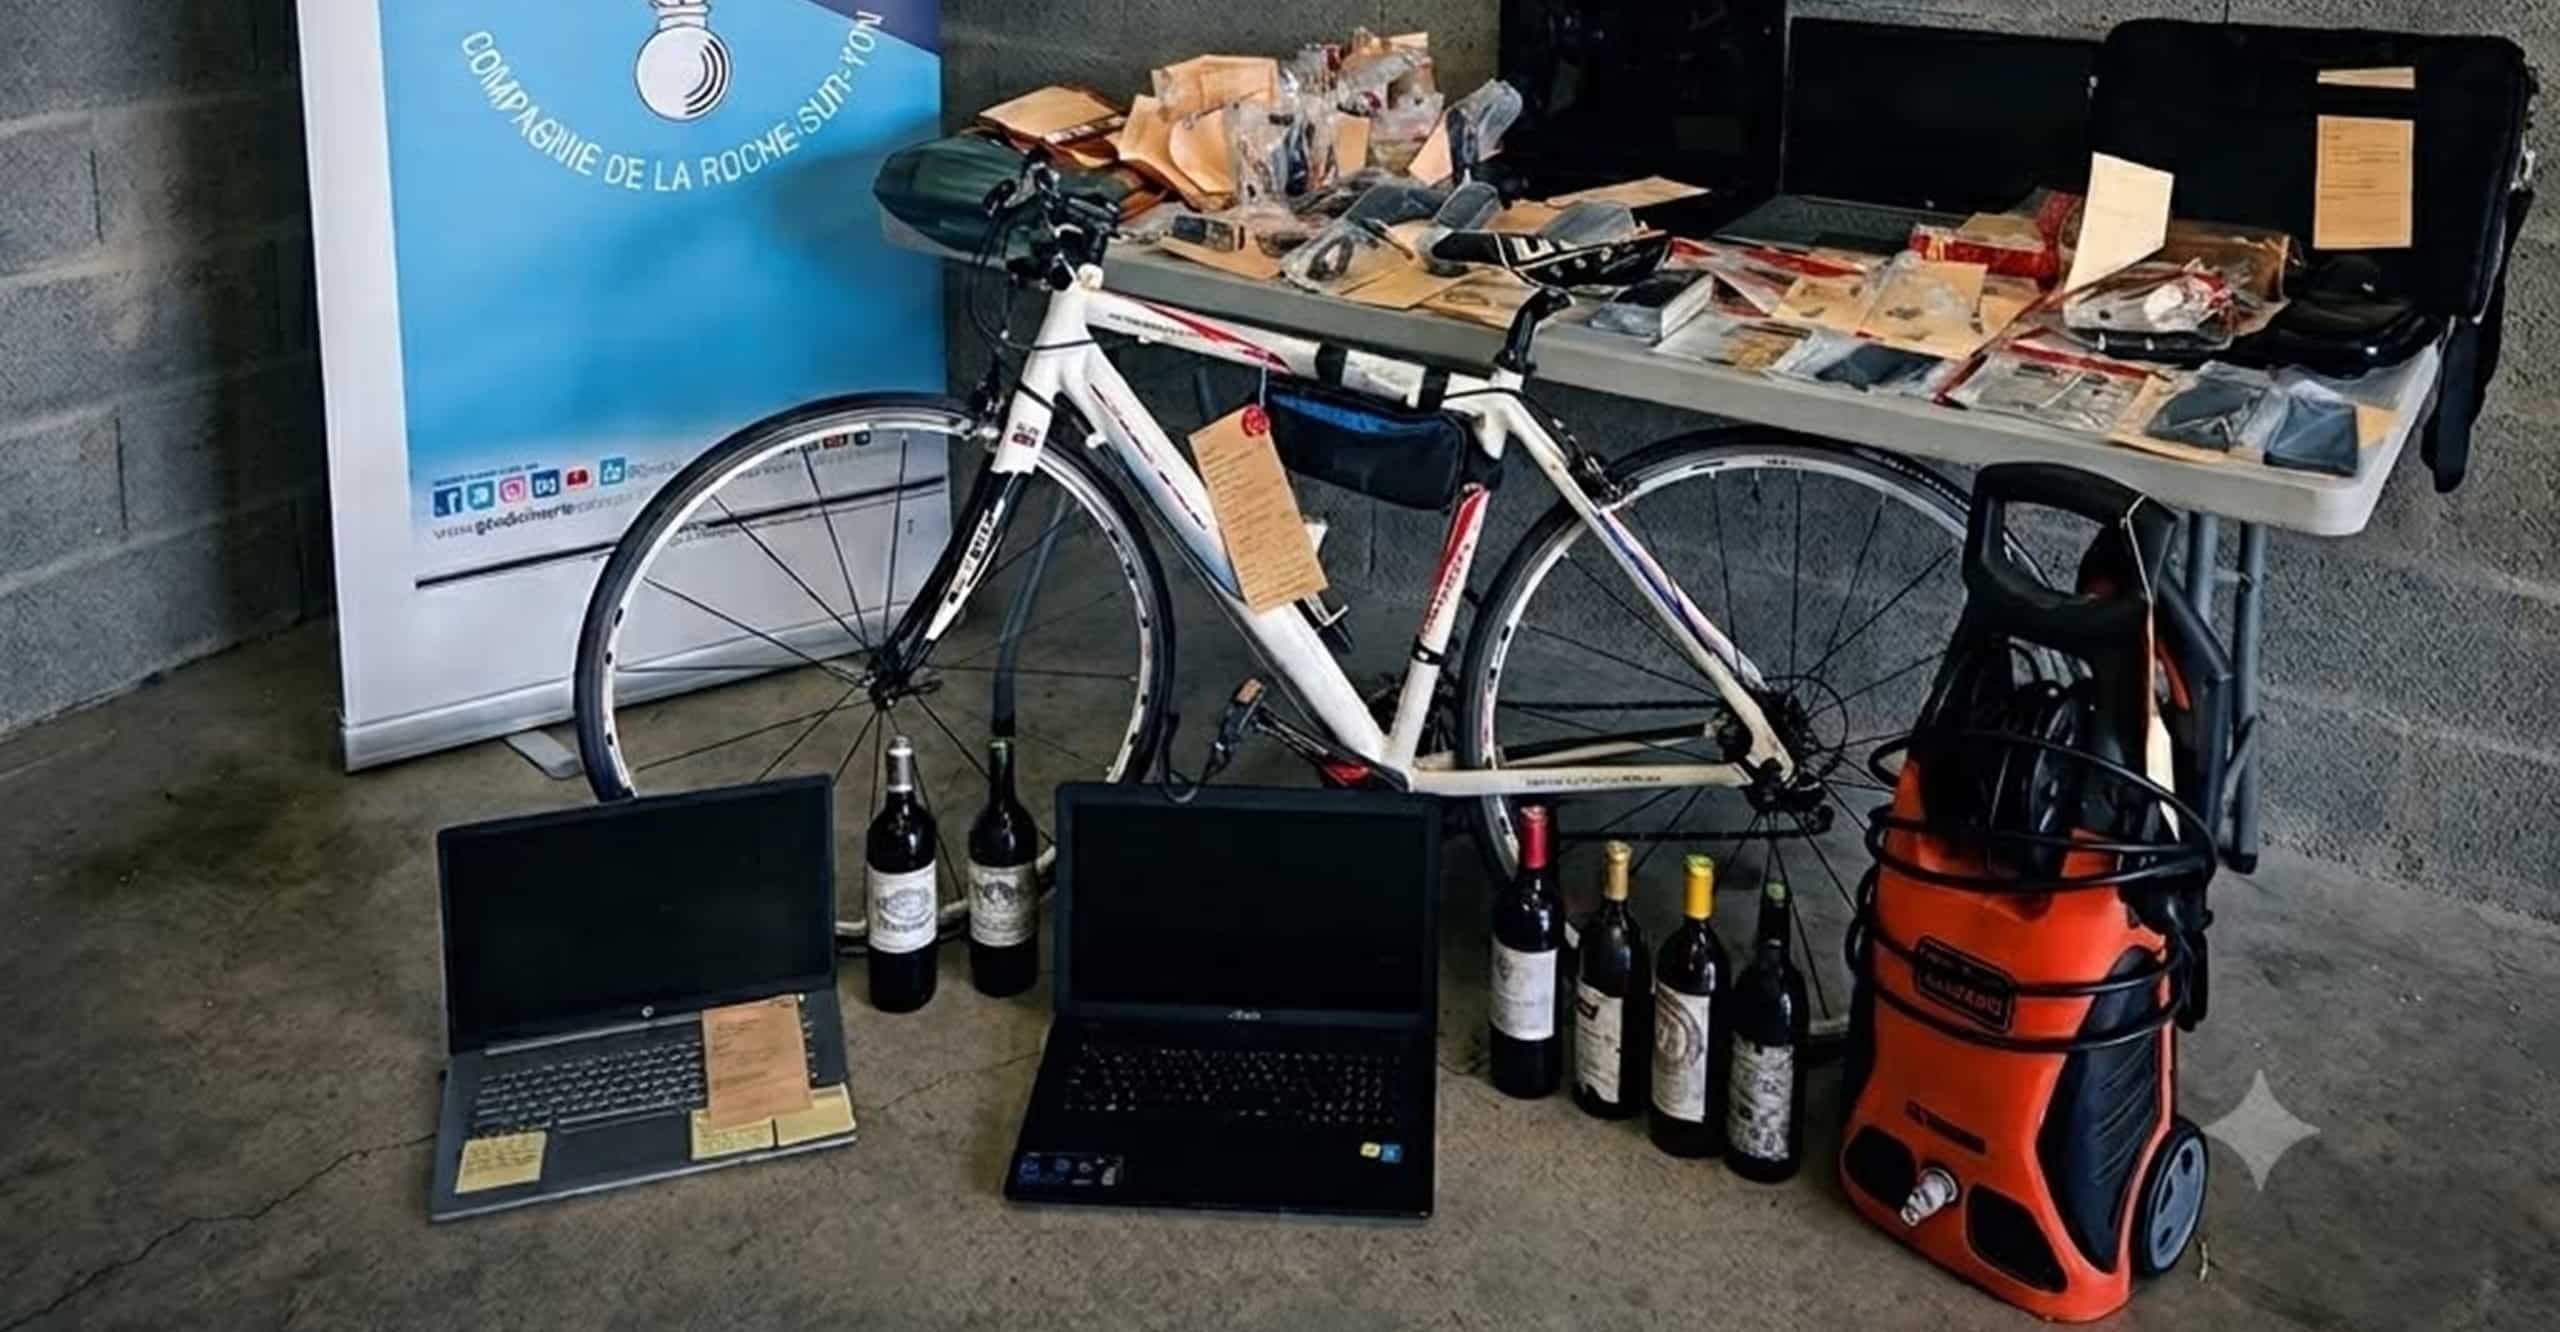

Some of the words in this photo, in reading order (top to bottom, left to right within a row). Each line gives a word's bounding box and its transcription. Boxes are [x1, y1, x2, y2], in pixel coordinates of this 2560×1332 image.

[462, 30, 602, 176] COMPAGNIE
[604, 153, 645, 190] DE
[654, 160, 692, 191] LA
